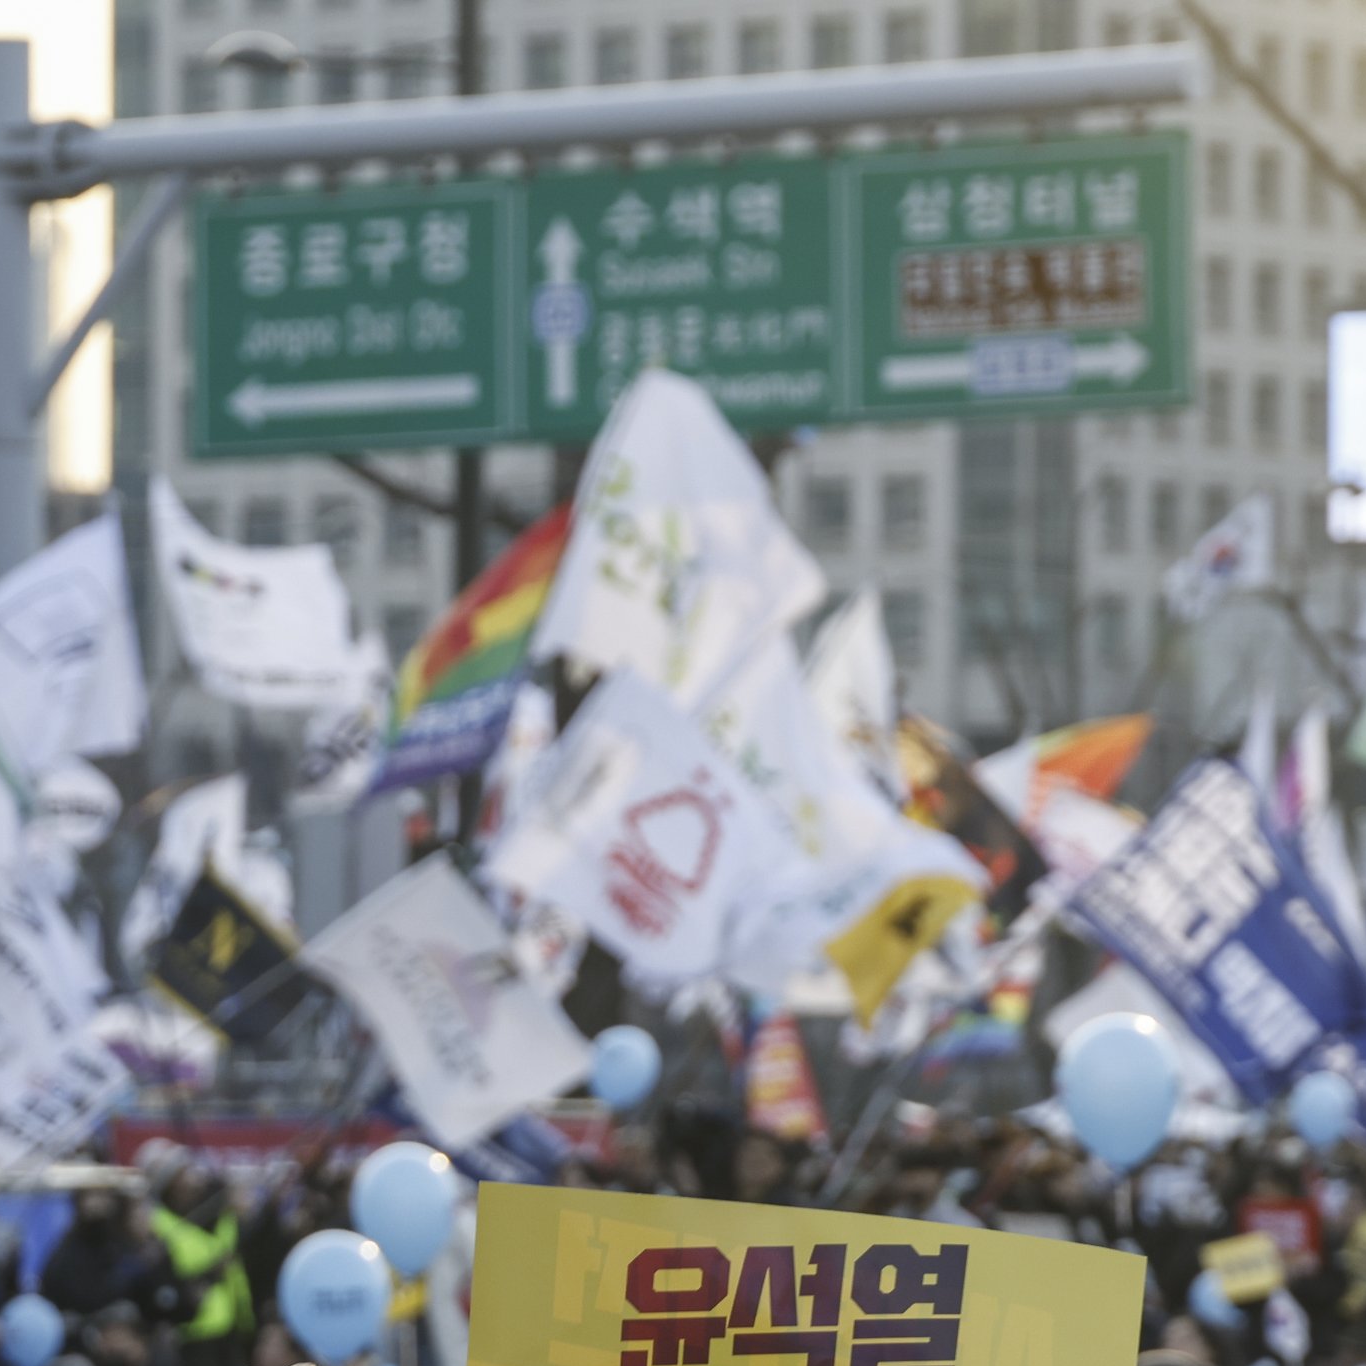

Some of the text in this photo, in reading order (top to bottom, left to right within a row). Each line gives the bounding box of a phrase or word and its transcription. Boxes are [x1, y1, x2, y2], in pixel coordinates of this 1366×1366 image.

[599, 180, 782, 248] 수색역
[900, 171, 1138, 240] 삼청터널
[237, 211, 470, 296] 종로구청
